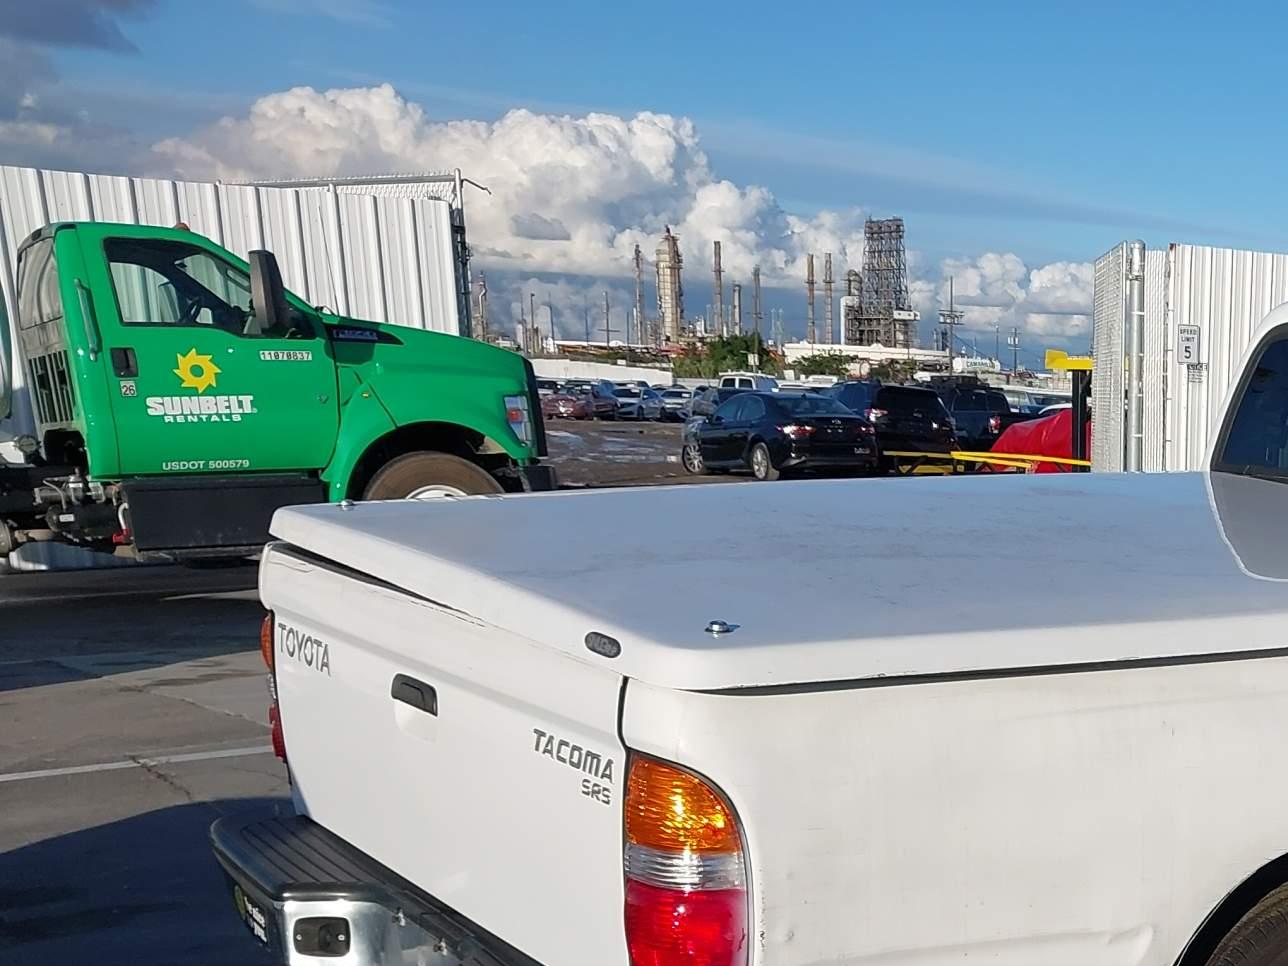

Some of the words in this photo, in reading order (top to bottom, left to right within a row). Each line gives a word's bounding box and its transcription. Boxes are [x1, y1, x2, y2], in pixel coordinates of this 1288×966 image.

[261, 351, 311, 360] 11070837
[1184, 345, 1192, 359] 5
[122, 384, 136, 396] 26
[146, 395, 254, 416] SUNBELT
[164, 415, 242, 423] RENTALS
[162, 460, 205, 471] USDOT
[208, 459, 250, 470] 500579
[278, 622, 331, 677] TOYOTA
[533, 728, 614, 784] TACOMA
